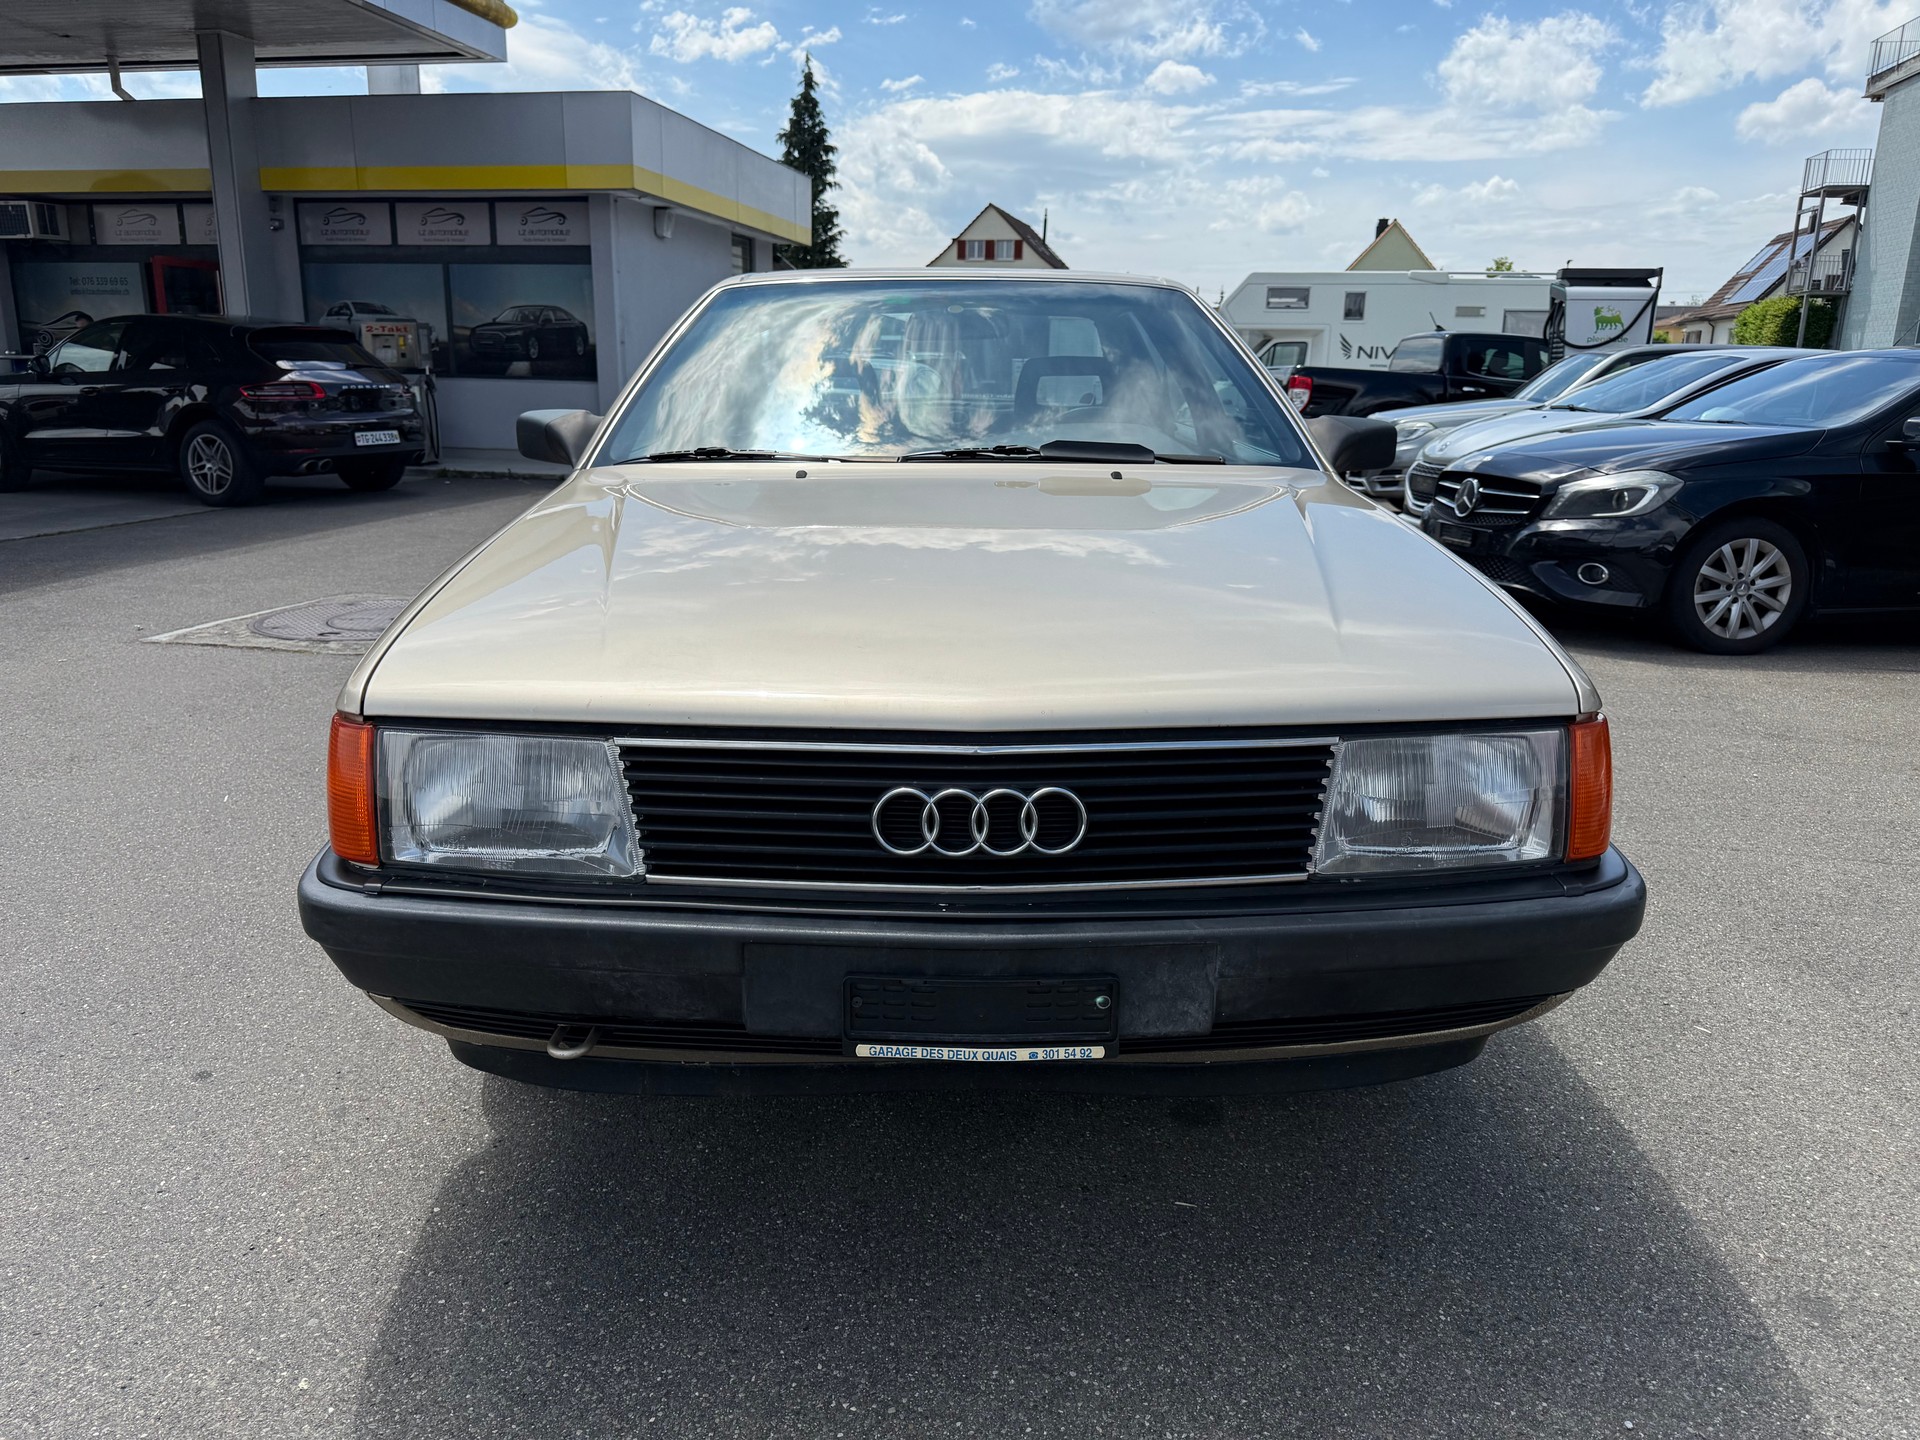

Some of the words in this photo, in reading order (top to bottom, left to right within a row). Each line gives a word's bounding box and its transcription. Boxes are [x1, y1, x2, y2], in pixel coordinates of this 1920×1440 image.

[365, 325, 408, 333] 2-Takt
[869, 1046, 918, 1058] GARAGE
[921, 1047, 944, 1059] DES
[947, 1049, 979, 1061] DEUX
[982, 1050, 1018, 1061] QUAIS
[1042, 1049, 1060, 1060] 301
[1063, 1048, 1077, 1059] 54
[1079, 1047, 1093, 1058] 92
